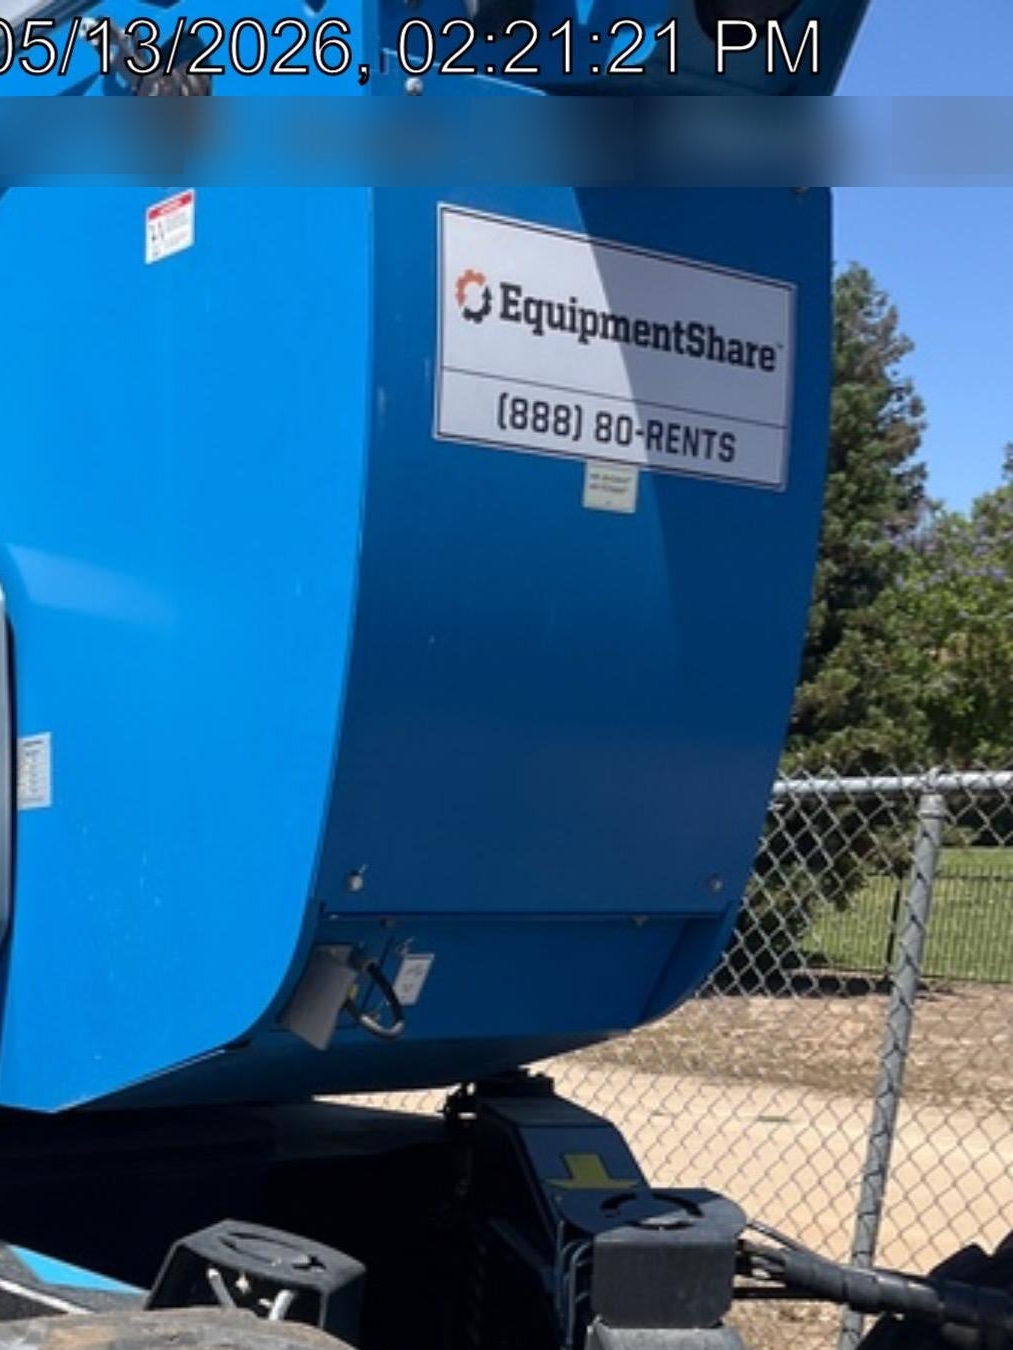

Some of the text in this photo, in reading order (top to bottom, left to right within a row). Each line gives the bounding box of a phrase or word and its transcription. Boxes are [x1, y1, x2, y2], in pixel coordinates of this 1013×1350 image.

[498, 281, 777, 373] EquipmentShare
[497, 391, 737, 464] (888) 80-RENTS
